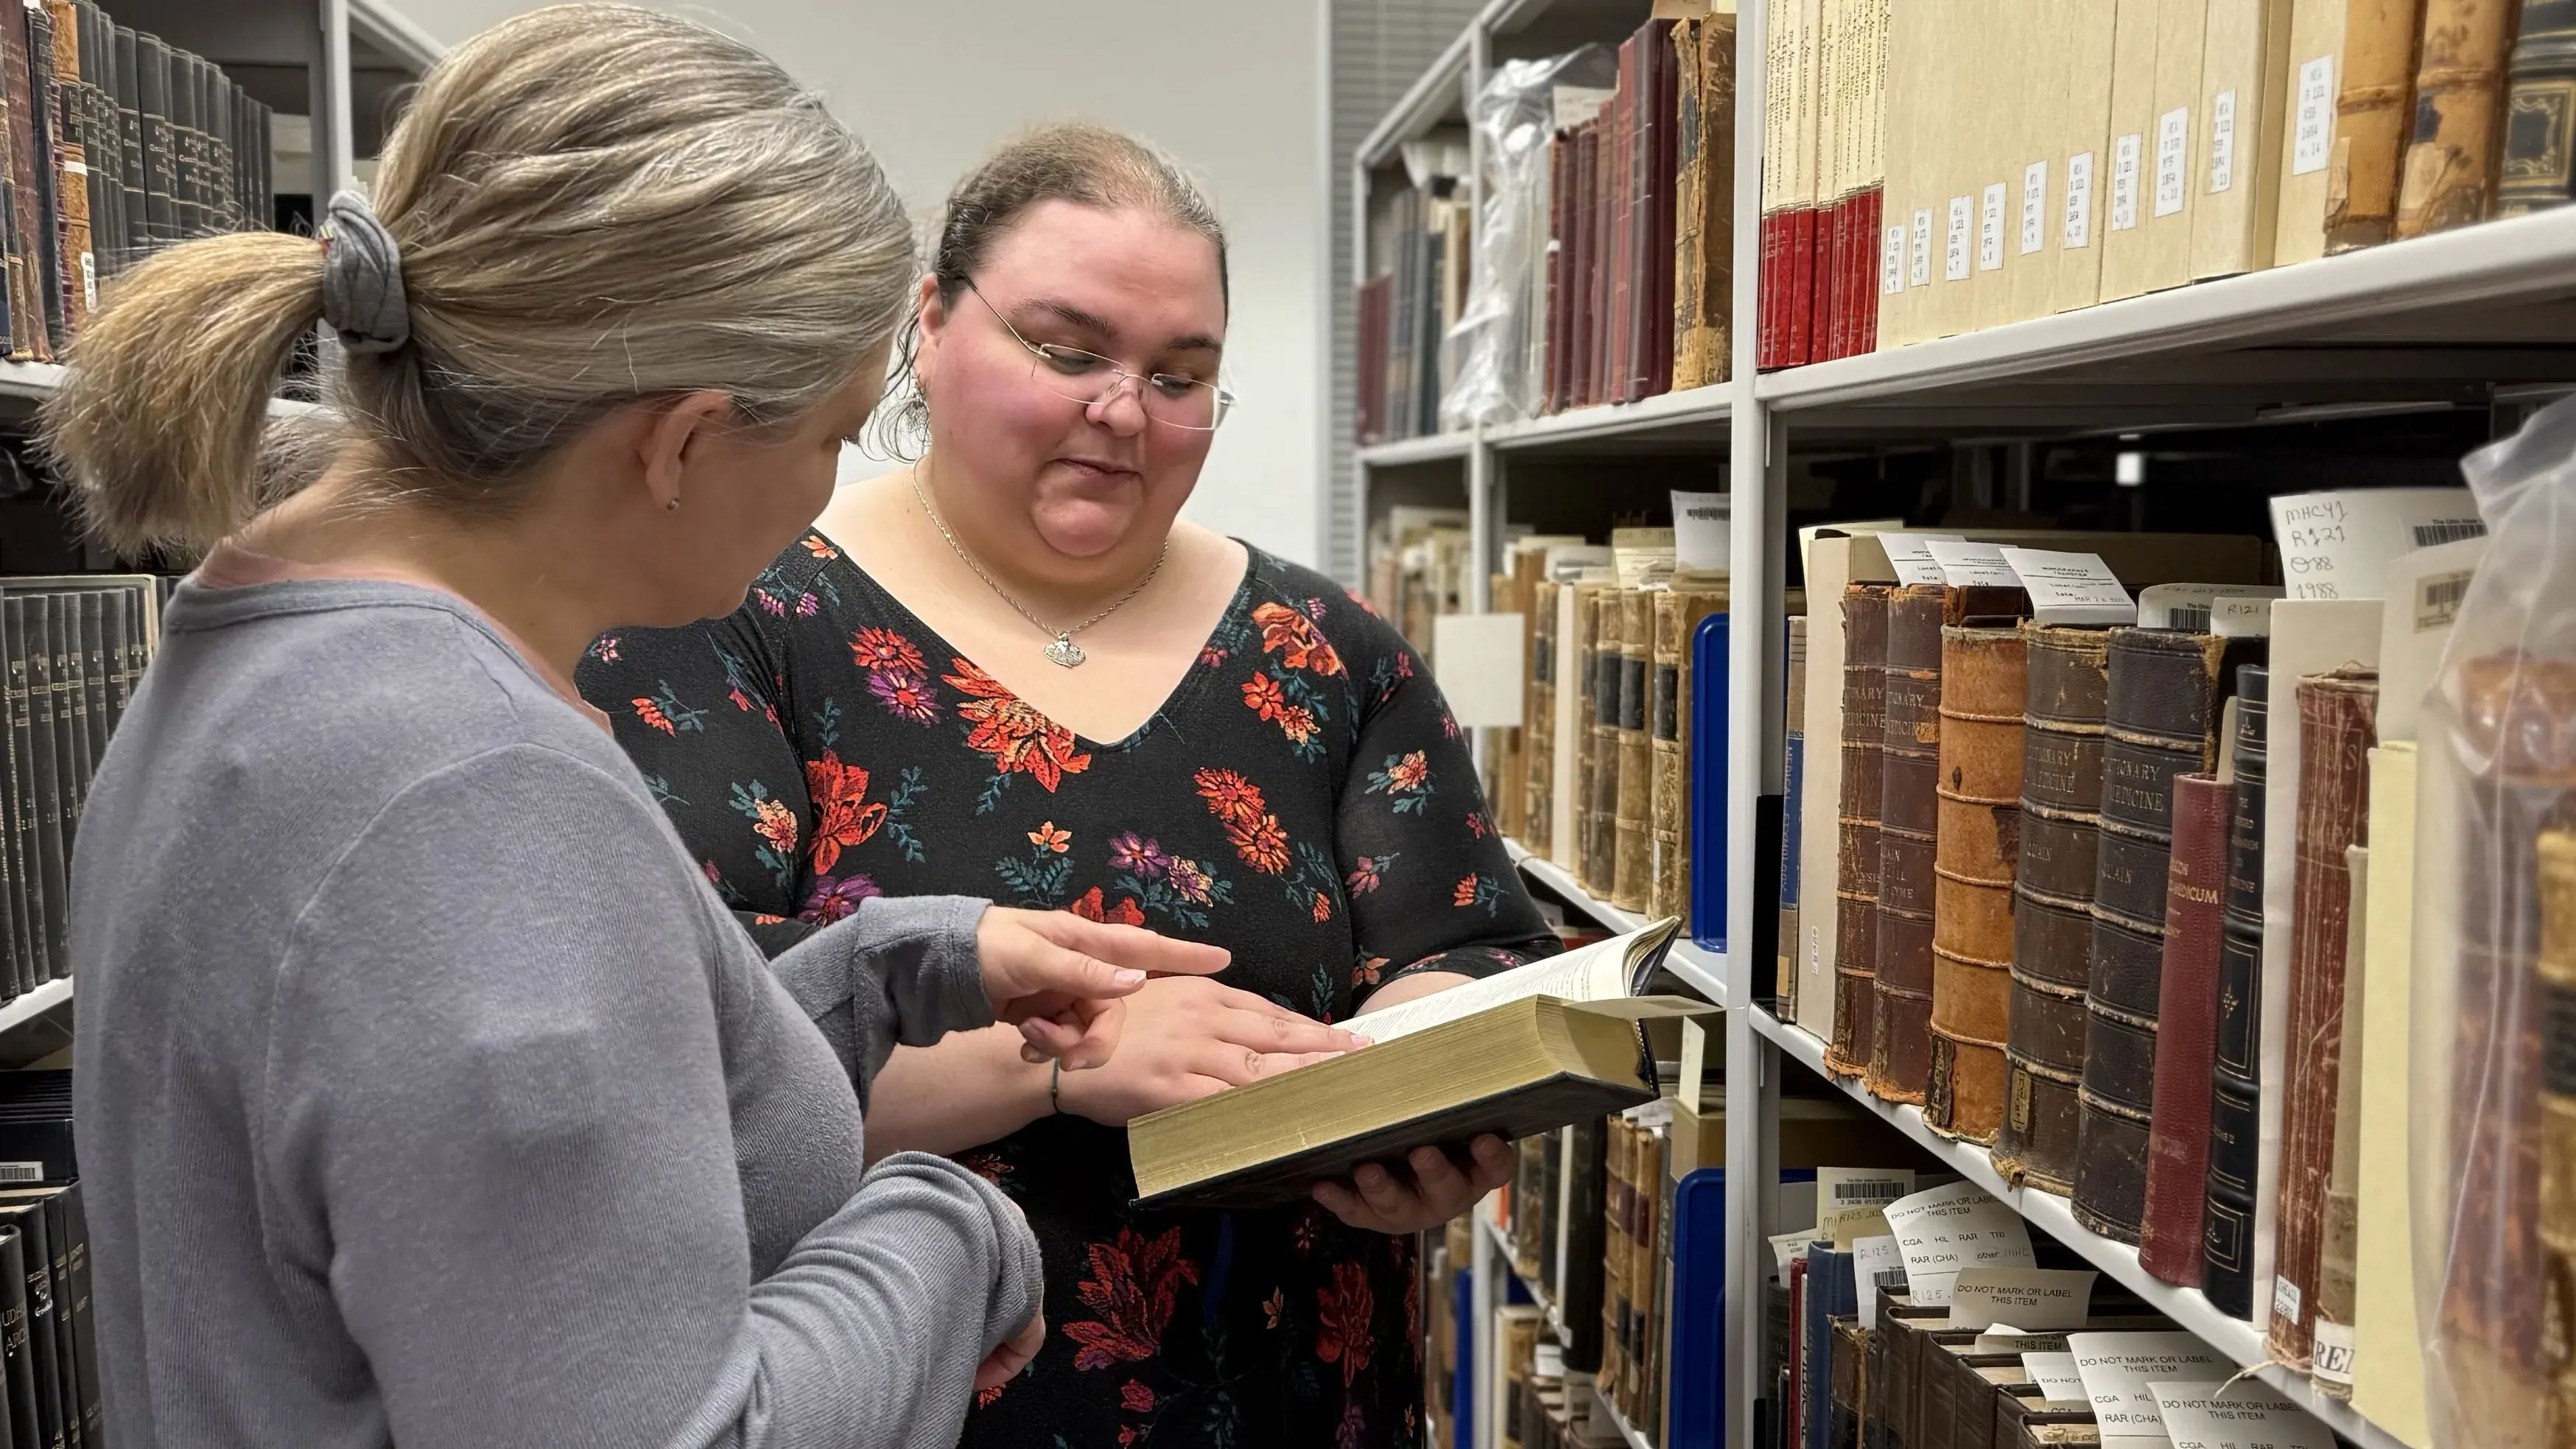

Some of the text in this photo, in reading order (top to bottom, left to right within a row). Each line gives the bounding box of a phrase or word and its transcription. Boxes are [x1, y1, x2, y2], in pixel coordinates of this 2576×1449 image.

[2292, 525, 2345, 547] R121
[2297, 582, 2339, 599] 1988
[2228, 604, 2259, 615] R121
[1906, 1206, 1926, 1215] NOT
[1956, 1196, 1970, 1206] OR
[1926, 1208, 1947, 1217] THIS
[1959, 1232, 1979, 1242] RAR
[1911, 1255, 1930, 1264] RAR
[1932, 1253, 1958, 1264] (CHA)
[1957, 1285, 1972, 1293] DO
[1974, 1285, 1995, 1294] NOT
[1997, 1287, 2024, 1295] MARK
[2043, 1289, 2073, 1298] LABEL
[1991, 1296, 2038, 1306] THIS ITEM
[2015, 1340, 2062, 1350] THIS ITEM
[2080, 1358, 2097, 1366] DO
[2099, 1356, 2123, 1364] NOT
[2126, 1355, 2158, 1364] MARK
[2178, 1355, 2214, 1364] LABEL
[2094, 1393, 2153, 1403] CGA HIL
[2163, 1400, 2180, 1408] DO
[2211, 1401, 2243, 1409] MARK
[2246, 1402, 2264, 1410] OR
[2105, 1414, 2163, 1425] RAR (CHA)
[2208, 1411, 2265, 1420] THIS ITEM
